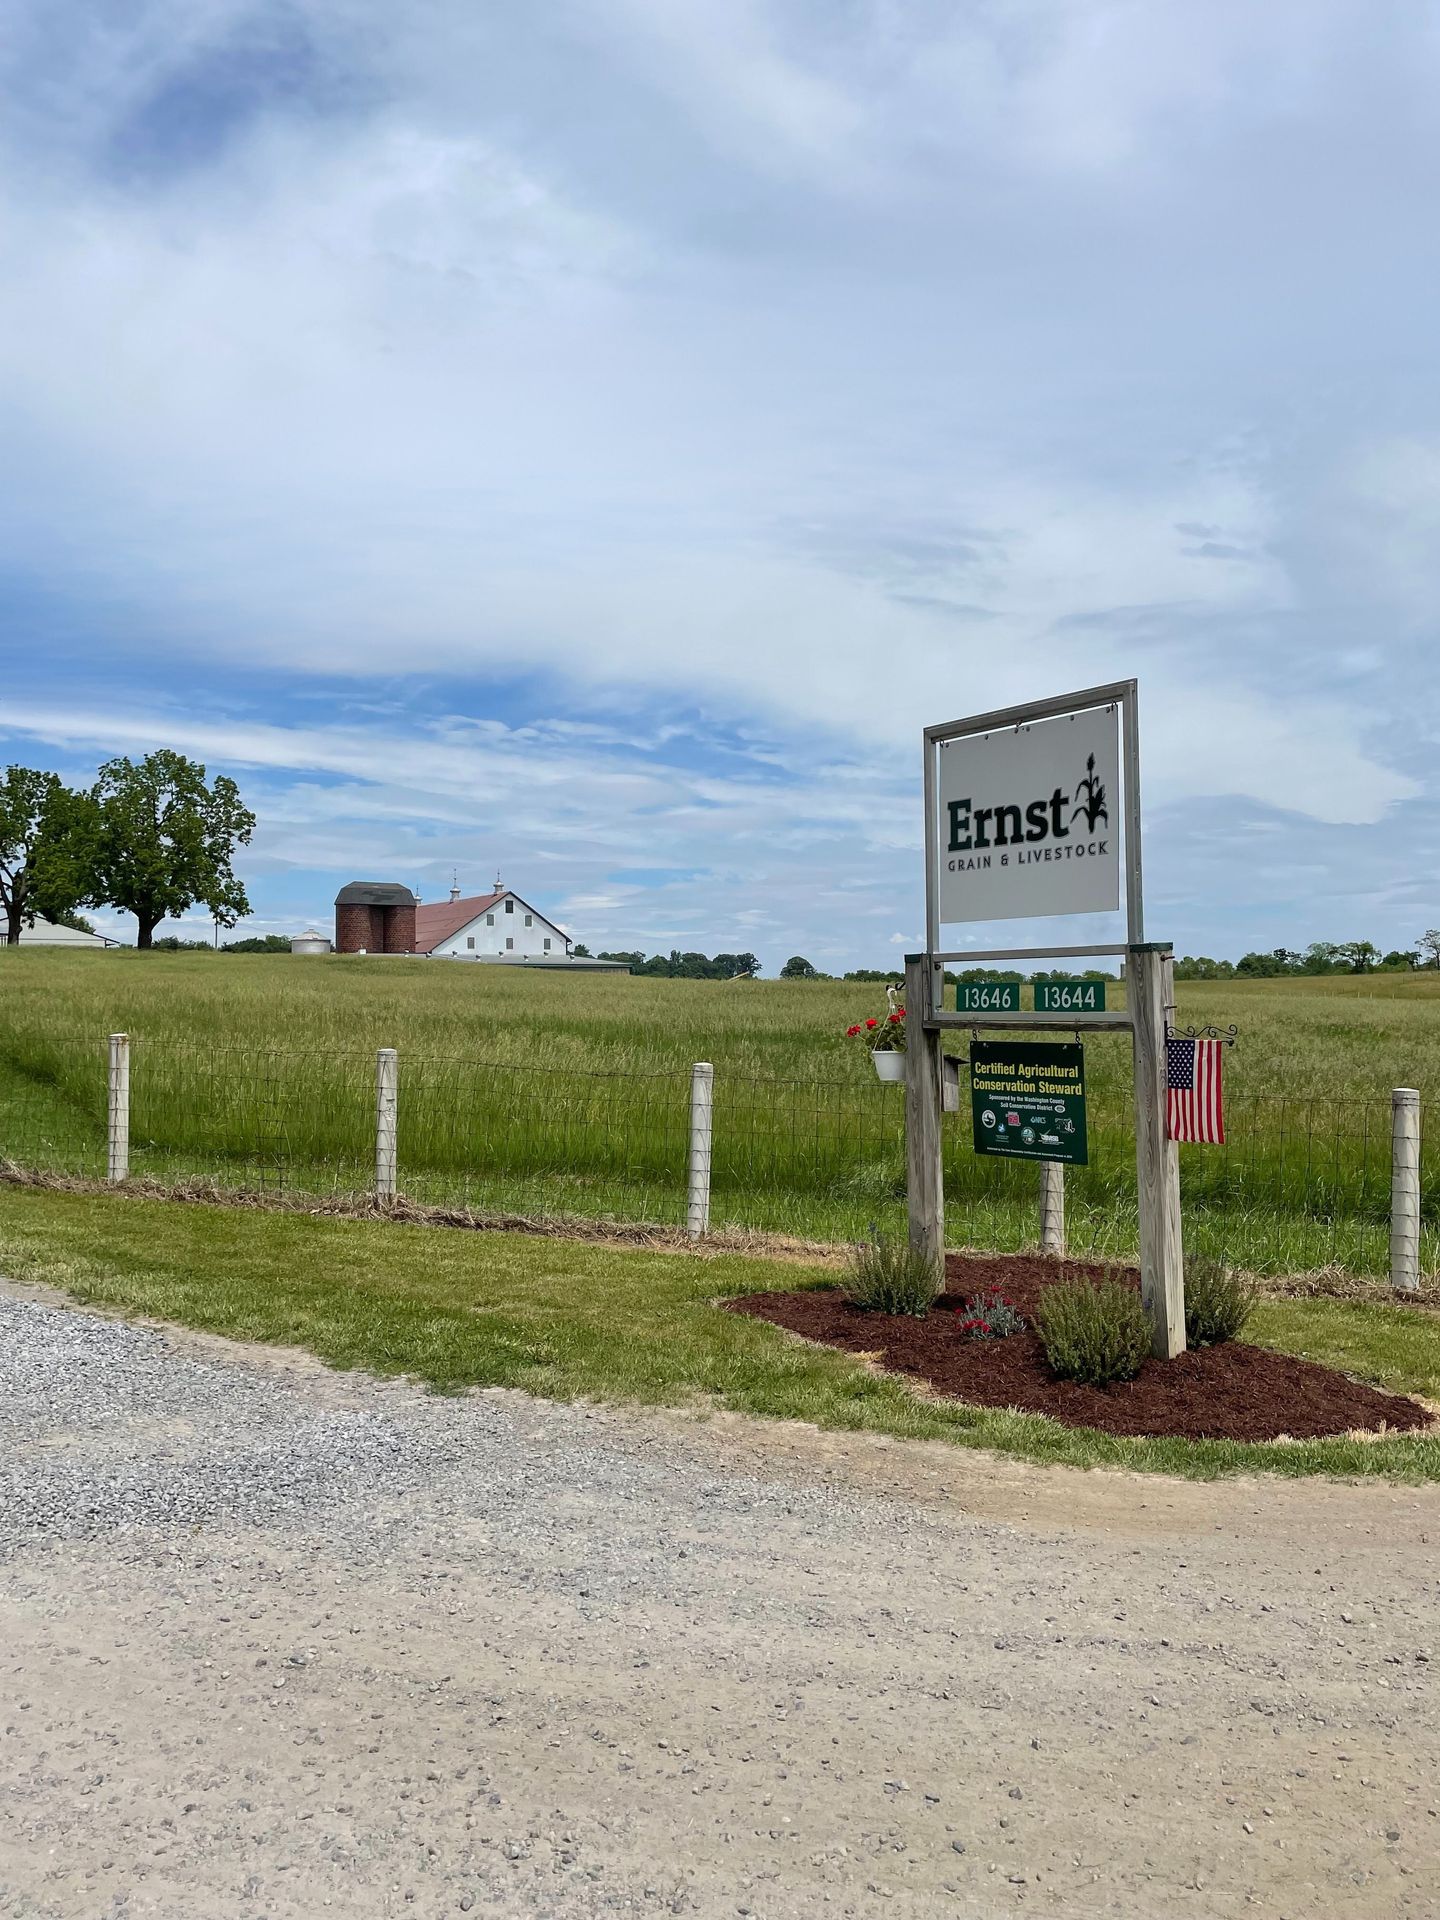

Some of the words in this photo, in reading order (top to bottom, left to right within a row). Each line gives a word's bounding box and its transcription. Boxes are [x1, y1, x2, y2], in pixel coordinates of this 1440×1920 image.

[948, 787, 1069, 853] Ernst
[948, 855, 992, 872] GRAIN
[1000, 854, 1009, 867] &
[1018, 841, 1109, 865] LIVESTOCK
[964, 987, 1011, 1009] 13646
[1043, 986, 1096, 1009] 13644
[974, 1061, 1015, 1075] Certified
[1017, 1063, 1079, 1079] Agricultural
[973, 1077, 1036, 1093] Conservation
[1038, 1080, 1083, 1096] Steward
[1009, 1102, 1036, 1110] Conservation
[1024, 1096, 1049, 1104] Washington
[1049, 1097, 1065, 1105] County
